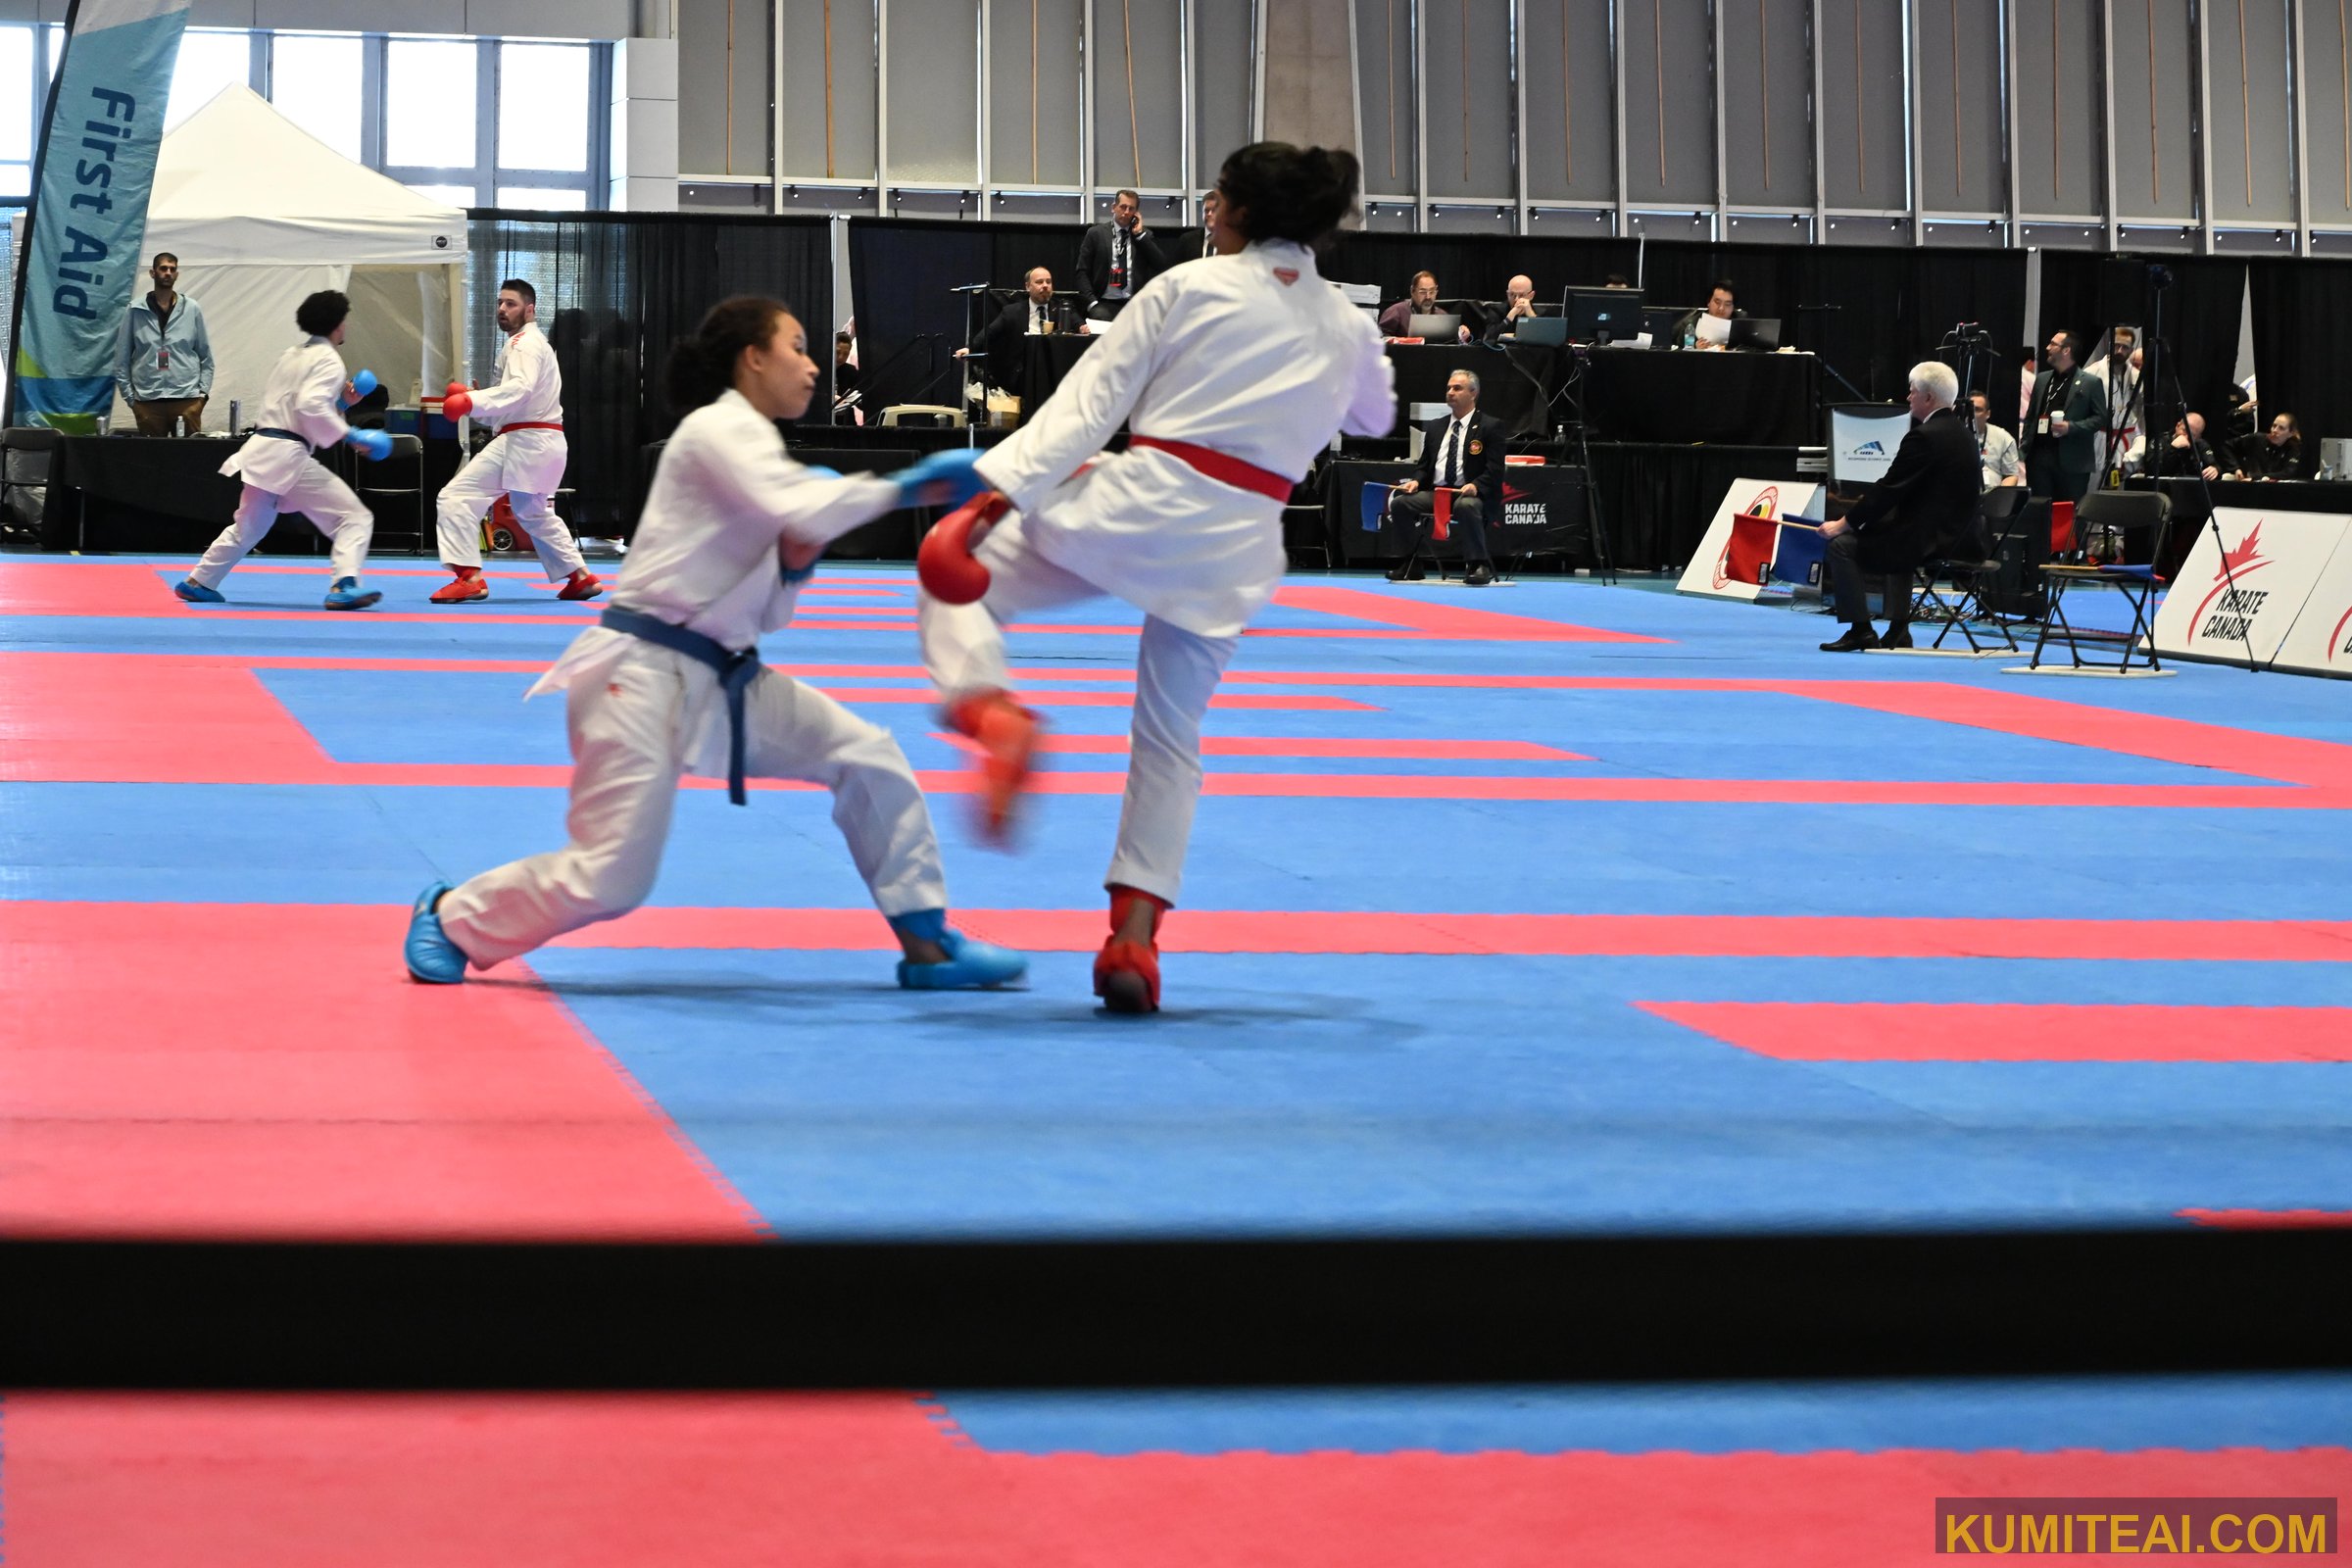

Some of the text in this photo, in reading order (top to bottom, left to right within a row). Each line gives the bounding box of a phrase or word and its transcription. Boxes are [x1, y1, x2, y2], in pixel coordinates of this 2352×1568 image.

[53, 86, 136, 319] First Aid
[1504, 503, 1546, 514] KARATE
[2216, 588, 2269, 614] KARATE
[2202, 615, 2252, 642] CANADA
